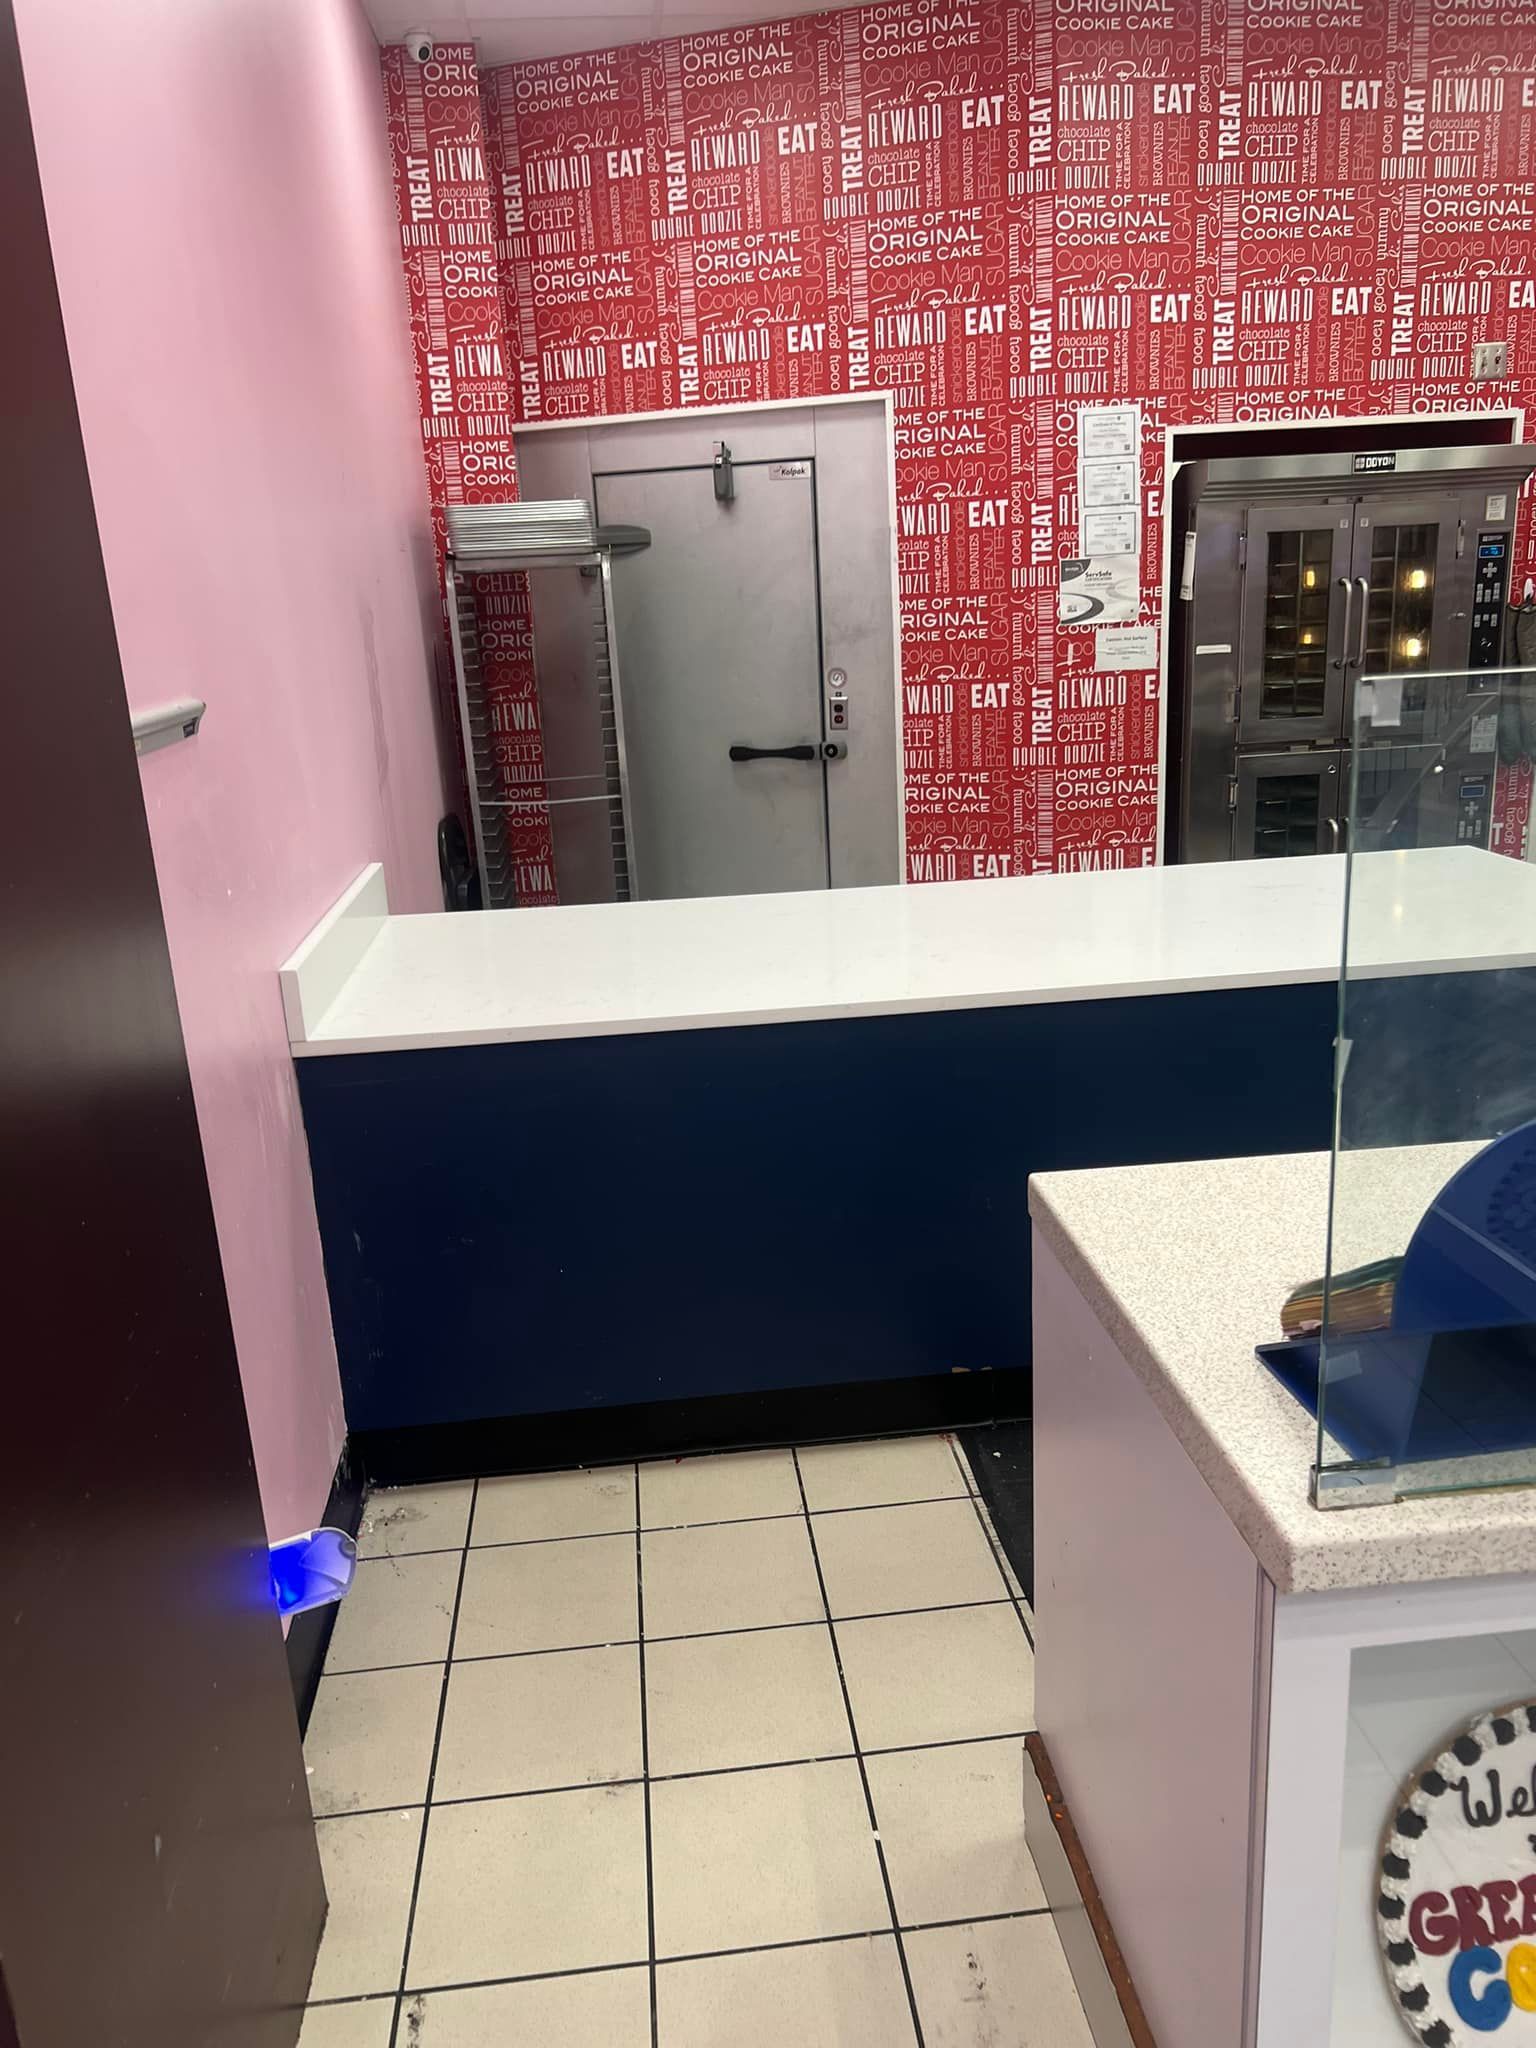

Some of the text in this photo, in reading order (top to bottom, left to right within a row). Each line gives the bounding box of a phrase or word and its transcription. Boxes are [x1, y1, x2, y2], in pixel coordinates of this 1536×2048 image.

[862, 12, 980, 44] ORIGINAL
[1056, 16, 1173, 30] COOKIE CAKE
[681, 23, 791, 52] HOME OF THE
[863, 32, 980, 60] COOKIE CAKE
[514, 52, 616, 80] HOME OF THE
[683, 42, 792, 72] ORIGINAL
[516, 70, 618, 98] ORIGINAL
[684, 61, 793, 88] COOKIE CAKE
[518, 88, 619, 114] COOKIE CAKE
[1059, 84, 1133, 121] REWARD
[1154, 84, 1195, 114] EAT
[1248, 80, 1321, 117] REWARD
[1341, 80, 1382, 110] EAT
[1432, 78, 1504, 112] REWARD
[868, 104, 942, 148] REWARD
[962, 95, 1004, 129] EAT
[778, 122, 817, 155] EAT
[1029, 97, 1052, 168] TREAT
[607, 148, 644, 179] EAT
[691, 130, 760, 172] REWARD
[841, 125, 863, 193] TREAT
[1057, 139, 1110, 162] CHIP
[526, 154, 591, 194] REWARD
[665, 150, 688, 215] TREAT
[1008, 165, 1110, 196] DOUBLE DOOZIE
[1056, 194, 1170, 209] HOME OF THE
[1242, 188, 1355, 204] HOME OF THE
[1424, 183, 1534, 197] HOME OF THE
[868, 207, 982, 233] HOME OF THE
[1056, 210, 1171, 230] ORIGINAL
[1242, 205, 1354, 224] ORIGINAL
[1424, 199, 1533, 218] ORIGINAL
[869, 227, 982, 252] ORIGINAL
[1056, 230, 1170, 246] COOKIE CAKE
[1241, 224, 1353, 240] COOKIE CAKE
[1422, 218, 1532, 233] COOKIE CAKE
[694, 230, 800, 254] HOME OF THE
[869, 244, 982, 268] COOKIE CAKE
[986, 201, 1005, 285] SUGAR
[441, 250, 492, 264] HOME
[532, 251, 631, 274] HOME OF THE
[696, 248, 801, 272] ORIGINAL
[1056, 248, 1169, 271] Cookie Man
[534, 267, 633, 291] ORIGINAL
[696, 265, 802, 288] COOKIE CAKE
[871, 262, 982, 292] Cookie Man
[1193, 214, 1207, 364] ooey gooey yummy
[1372, 208, 1391, 356] ooey gooey yummy
[535, 285, 634, 306] COOKIE CAKE
[1151, 294, 1191, 322] EAT
[1242, 288, 1313, 324] REWARD
[1332, 286, 1372, 315] EAT
[1420, 281, 1491, 316] REWARD
[965, 304, 1006, 335] EAT
[1059, 295, 1131, 331] REWARD
[1391, 292, 1414, 356] TREAT
[787, 323, 825, 352] EAT
[875, 310, 946, 350] REWARD
[1030, 307, 1052, 373] TREAT
[1057, 334, 1108, 346] chocolate
[1136, 294, 1146, 390] snickerdoodle
[1213, 299, 1235, 365] TREAT
[1417, 332, 1467, 353] CHIP
[622, 341, 657, 369] EAT
[703, 327, 770, 366] REWARD
[848, 327, 870, 390] TREAT
[874, 350, 924, 364] chocolate
[1057, 347, 1108, 368] CHIP
[1150, 330, 1160, 390] BROWNIES
[1164, 325, 1174, 389] PEANUT
[1174, 324, 1185, 389] BUTTER
[1239, 340, 1290, 361] CHIP
[543, 345, 607, 382] REWARD
[678, 344, 700, 404] TREAT
[875, 362, 925, 385] CHIP
[966, 342, 976, 402] BROWNIES
[1193, 366, 1238, 389] DOUBLE
[1246, 364, 1289, 386] DOOZIE
[1371, 356, 1466, 380] DOUBLE DOOZIE
[427, 354, 453, 415] TREAT
[520, 361, 541, 419] TREAT
[704, 378, 751, 400] CHIP
[1010, 371, 1108, 398] DOUBLE DOOZIE
[458, 392, 508, 412] CHIP
[468, 414, 512, 436] DOOZIE
[460, 440, 509, 453] HOME
[1366, 456, 1395, 468] DOYON
[968, 499, 1008, 527] EAT
[1031, 503, 1052, 564] TREAT
[970, 533, 980, 590] BROWNIES
[972, 683, 1010, 708] EAT
[1059, 676, 1126, 709] REWARD
[1057, 722, 1106, 742] CHIP
[1056, 764, 1159, 781] HOME OF THE
[1056, 779, 1158, 798] ORIGINAL
[1056, 795, 1158, 811] COOKIE CAKE
[973, 854, 1010, 878] EAT
